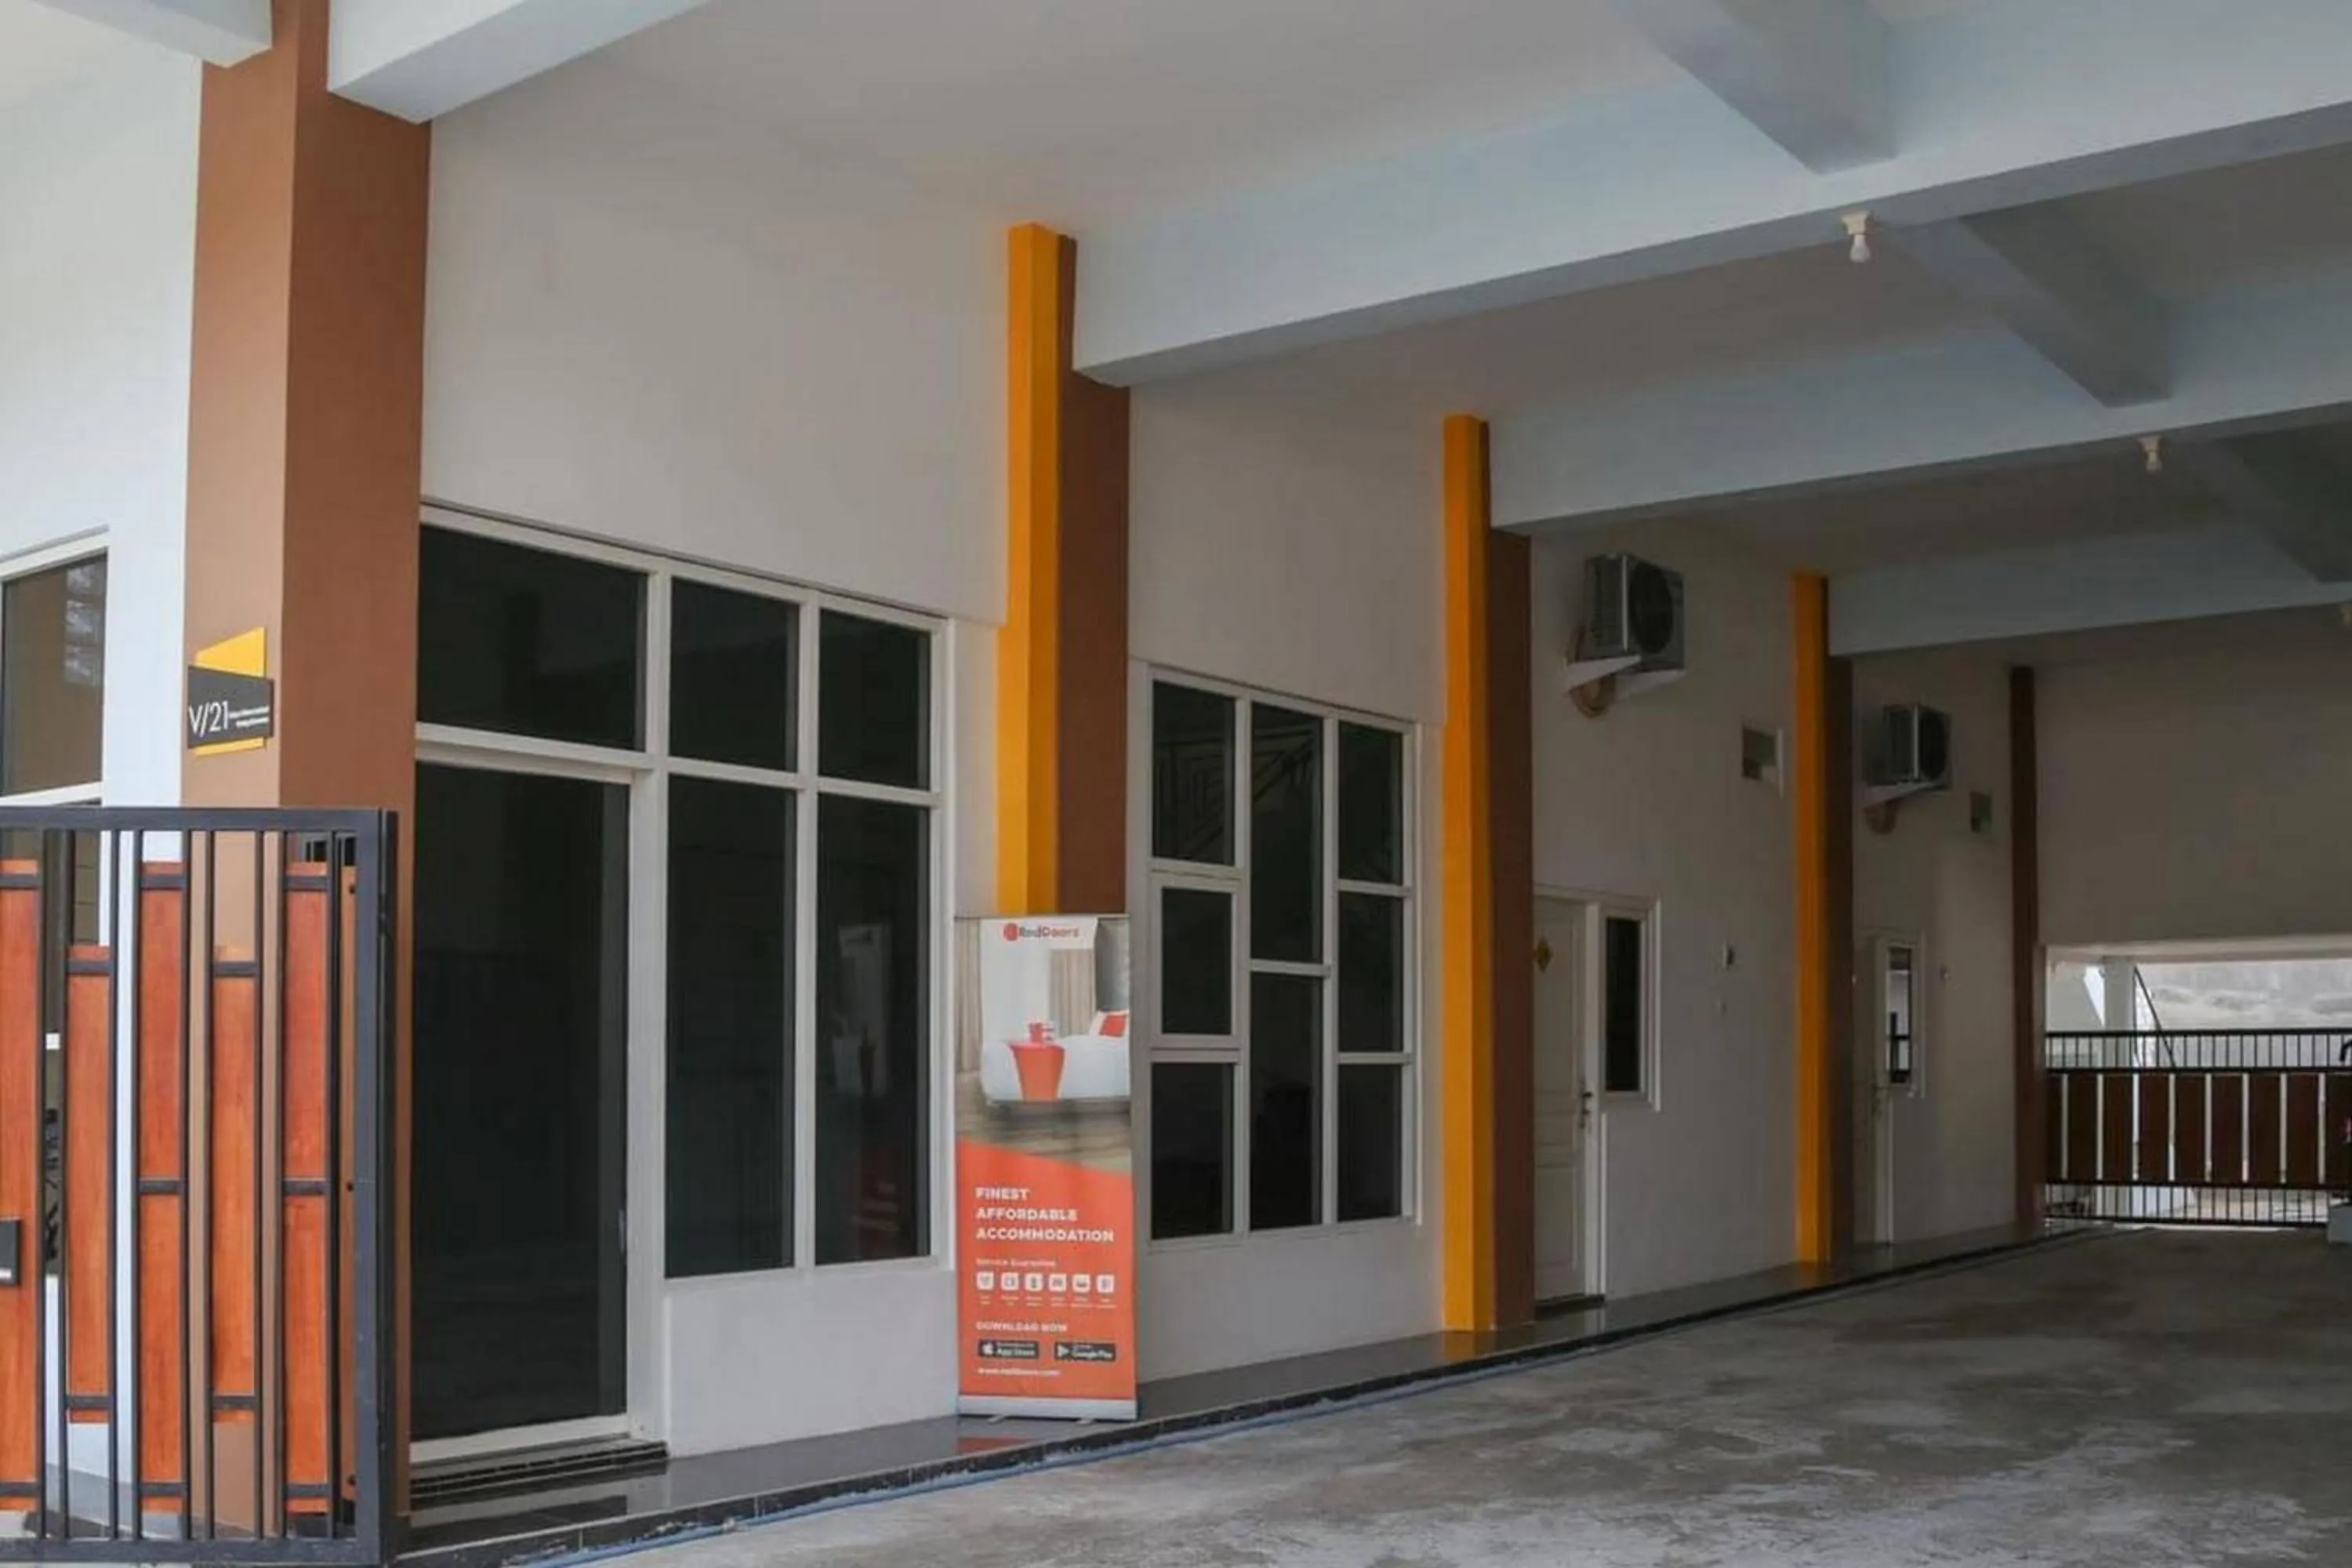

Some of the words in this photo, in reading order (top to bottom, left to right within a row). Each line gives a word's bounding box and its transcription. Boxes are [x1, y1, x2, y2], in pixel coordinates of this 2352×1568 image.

[975, 1187, 1029, 1200] FINEST
[976, 1207, 1078, 1221] AFFORDABLE
[976, 1228, 1114, 1243] ACCOMMODATION
[976, 1321, 1040, 1332] DOWNLOAD
